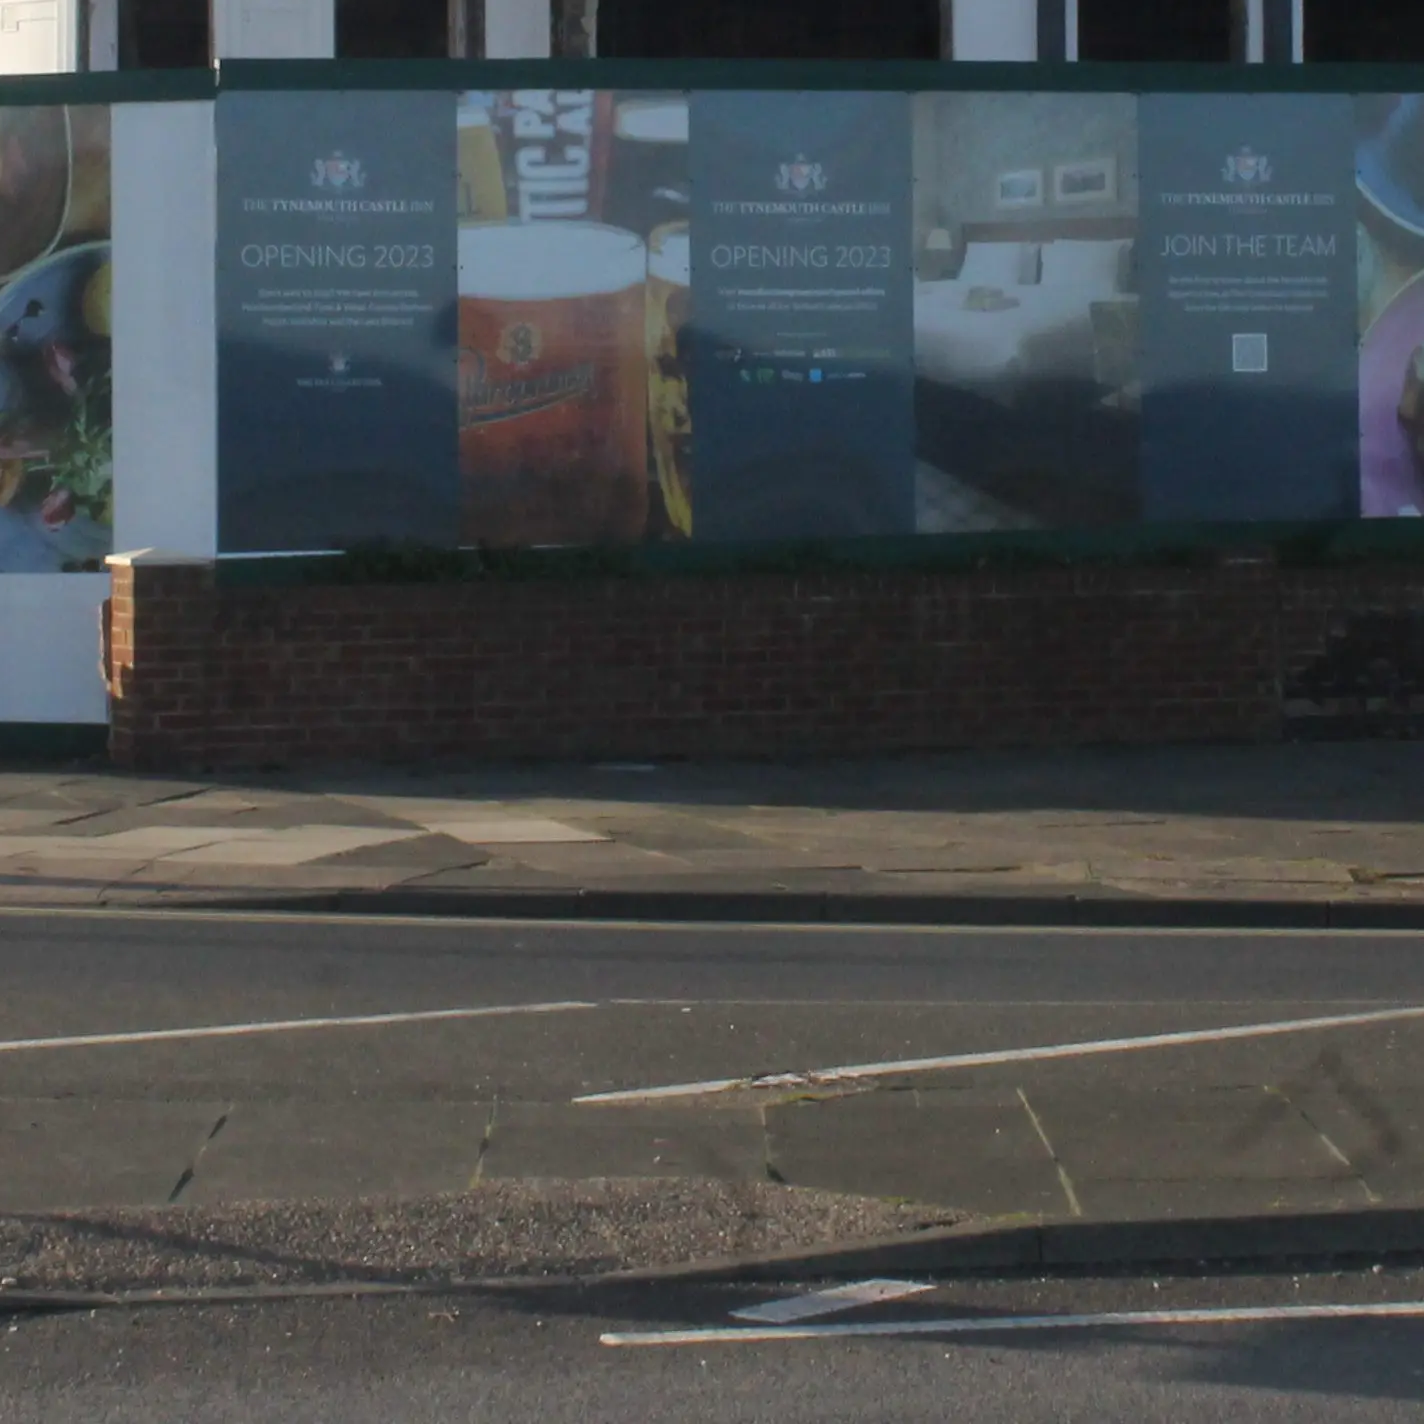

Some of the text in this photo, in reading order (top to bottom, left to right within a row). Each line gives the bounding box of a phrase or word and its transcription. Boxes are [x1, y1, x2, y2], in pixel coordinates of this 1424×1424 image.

[272, 199, 357, 212] TYNEMOUTH
[359, 199, 406, 212] CASTLE
[740, 202, 819, 214] TYNEMOUTH
[821, 202, 865, 214] CASTLE
[241, 244, 434, 268] OPENING 2023
[711, 244, 891, 268] OPENING 2023
[1160, 233, 1336, 257] JOIN THE TEAM
